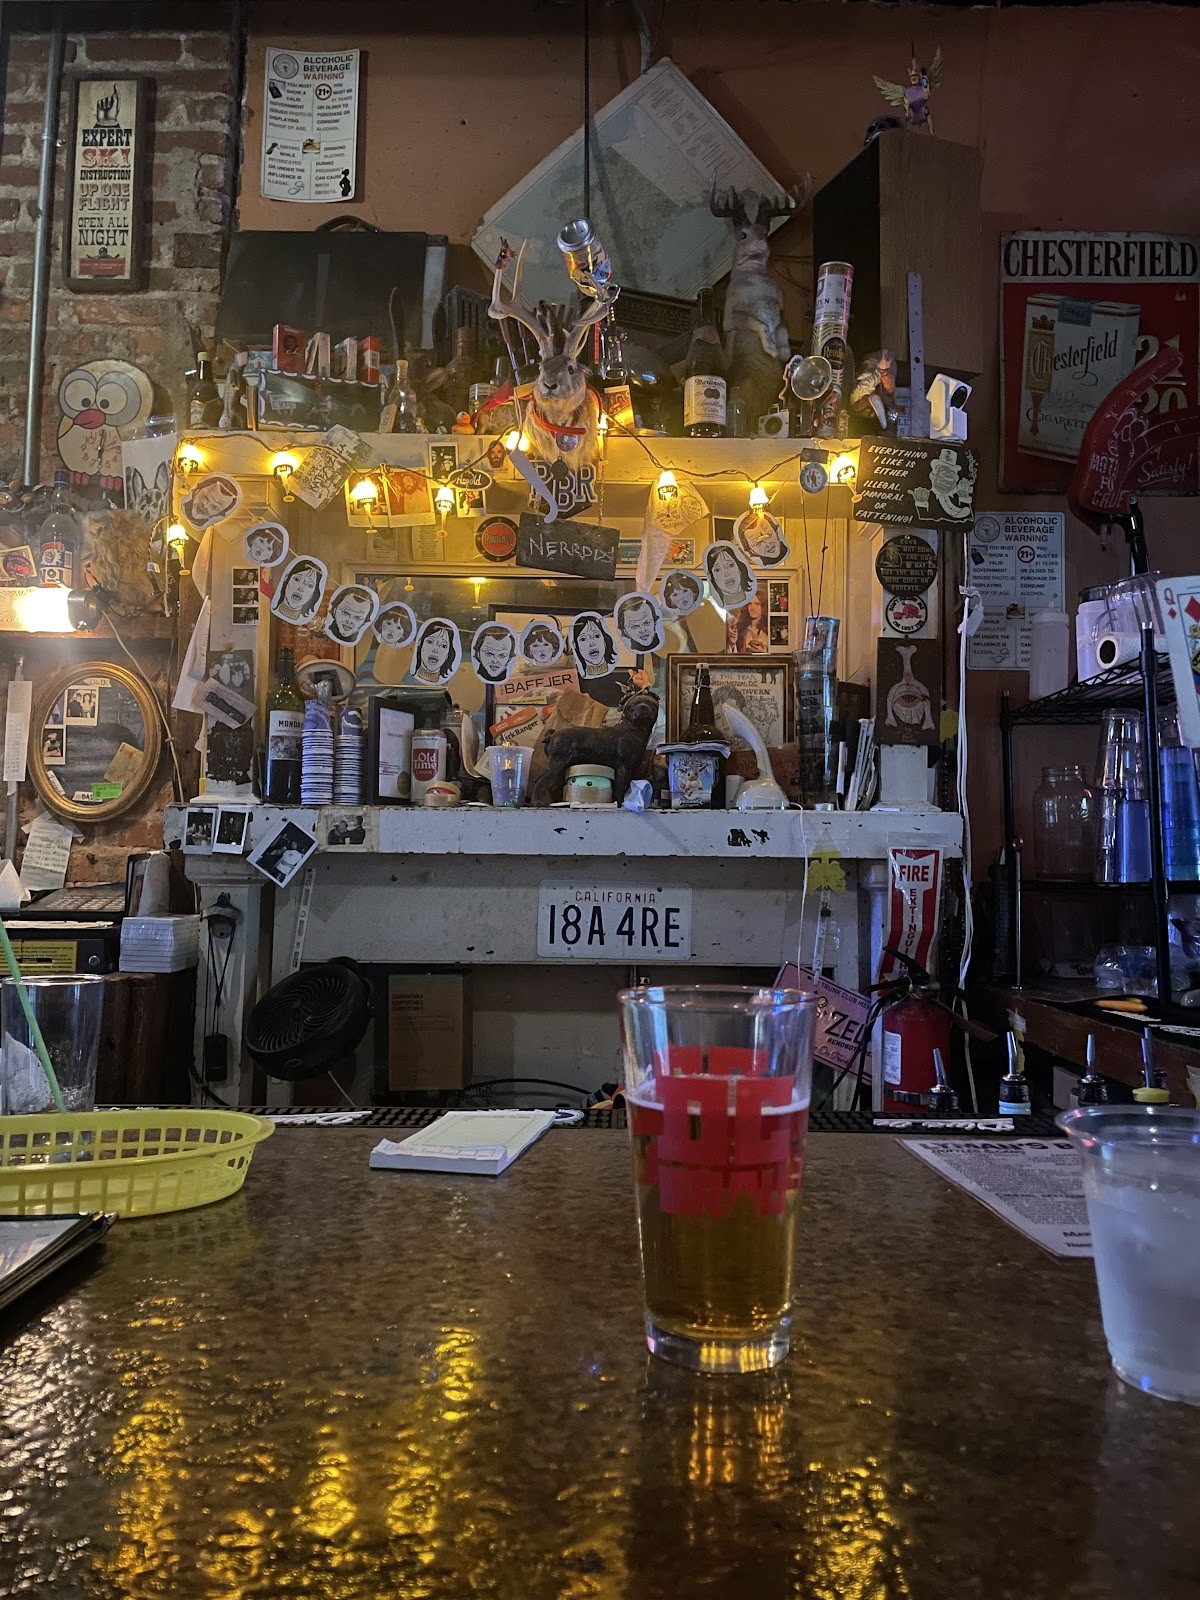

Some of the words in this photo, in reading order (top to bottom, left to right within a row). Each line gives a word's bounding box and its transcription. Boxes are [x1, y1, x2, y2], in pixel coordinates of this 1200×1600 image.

[303, 54, 354, 64] ALCOHOLIC
[303, 63, 351, 72] BEVERAGE
[303, 72, 344, 80] WARNING
[318, 88, 330, 96] 21+
[82, 129, 132, 147] EXPERT
[81, 148, 131, 168] SKI
[80, 169, 131, 181] INSTRUCTION
[80, 183, 98, 197] UP
[102, 183, 130, 197] ONE
[79, 198, 130, 211] FLIGHT
[78, 217, 103, 228] OPEN
[107, 217, 129, 228] ALL
[78, 229, 129, 246] NIGHT
[1003, 239, 1198, 277] CHESTERFIELD
[1031, 329, 1119, 387] Chesterfield
[1026, 407, 1089, 432] CIGARETT
[867, 445, 928, 459] EVERYTHING
[881, 457, 905, 467] LIKE
[905, 460, 917, 468] IS
[873, 466, 909, 478] EITHER
[529, 460, 598, 512] PBR
[861, 490, 905, 501] IMMORAL
[874, 501, 887, 510] OR
[855, 510, 913, 523] FATTENING!
[1004, 516, 1058, 525] ALCOHOLIC
[1004, 526, 1055, 534] BEVERAGE
[484, 533, 515, 546] PINBALL
[1004, 535, 1048, 543] WARNING
[1020, 550, 1034, 558] 21+
[1164, 587, 1176, 605] Q
[514, 720, 538, 735] Ranger
[418, 752, 437, 762] Old
[413, 759, 437, 770] Time
[899, 865, 930, 882] FIRE
[575, 890, 656, 904] CALIFORNIA
[615, 906, 680, 948] 4RE
[821, 982, 840, 994] TRUNK
[841, 992, 858, 1004] CLUB
[826, 1037, 858, 1051] REHOBOT
